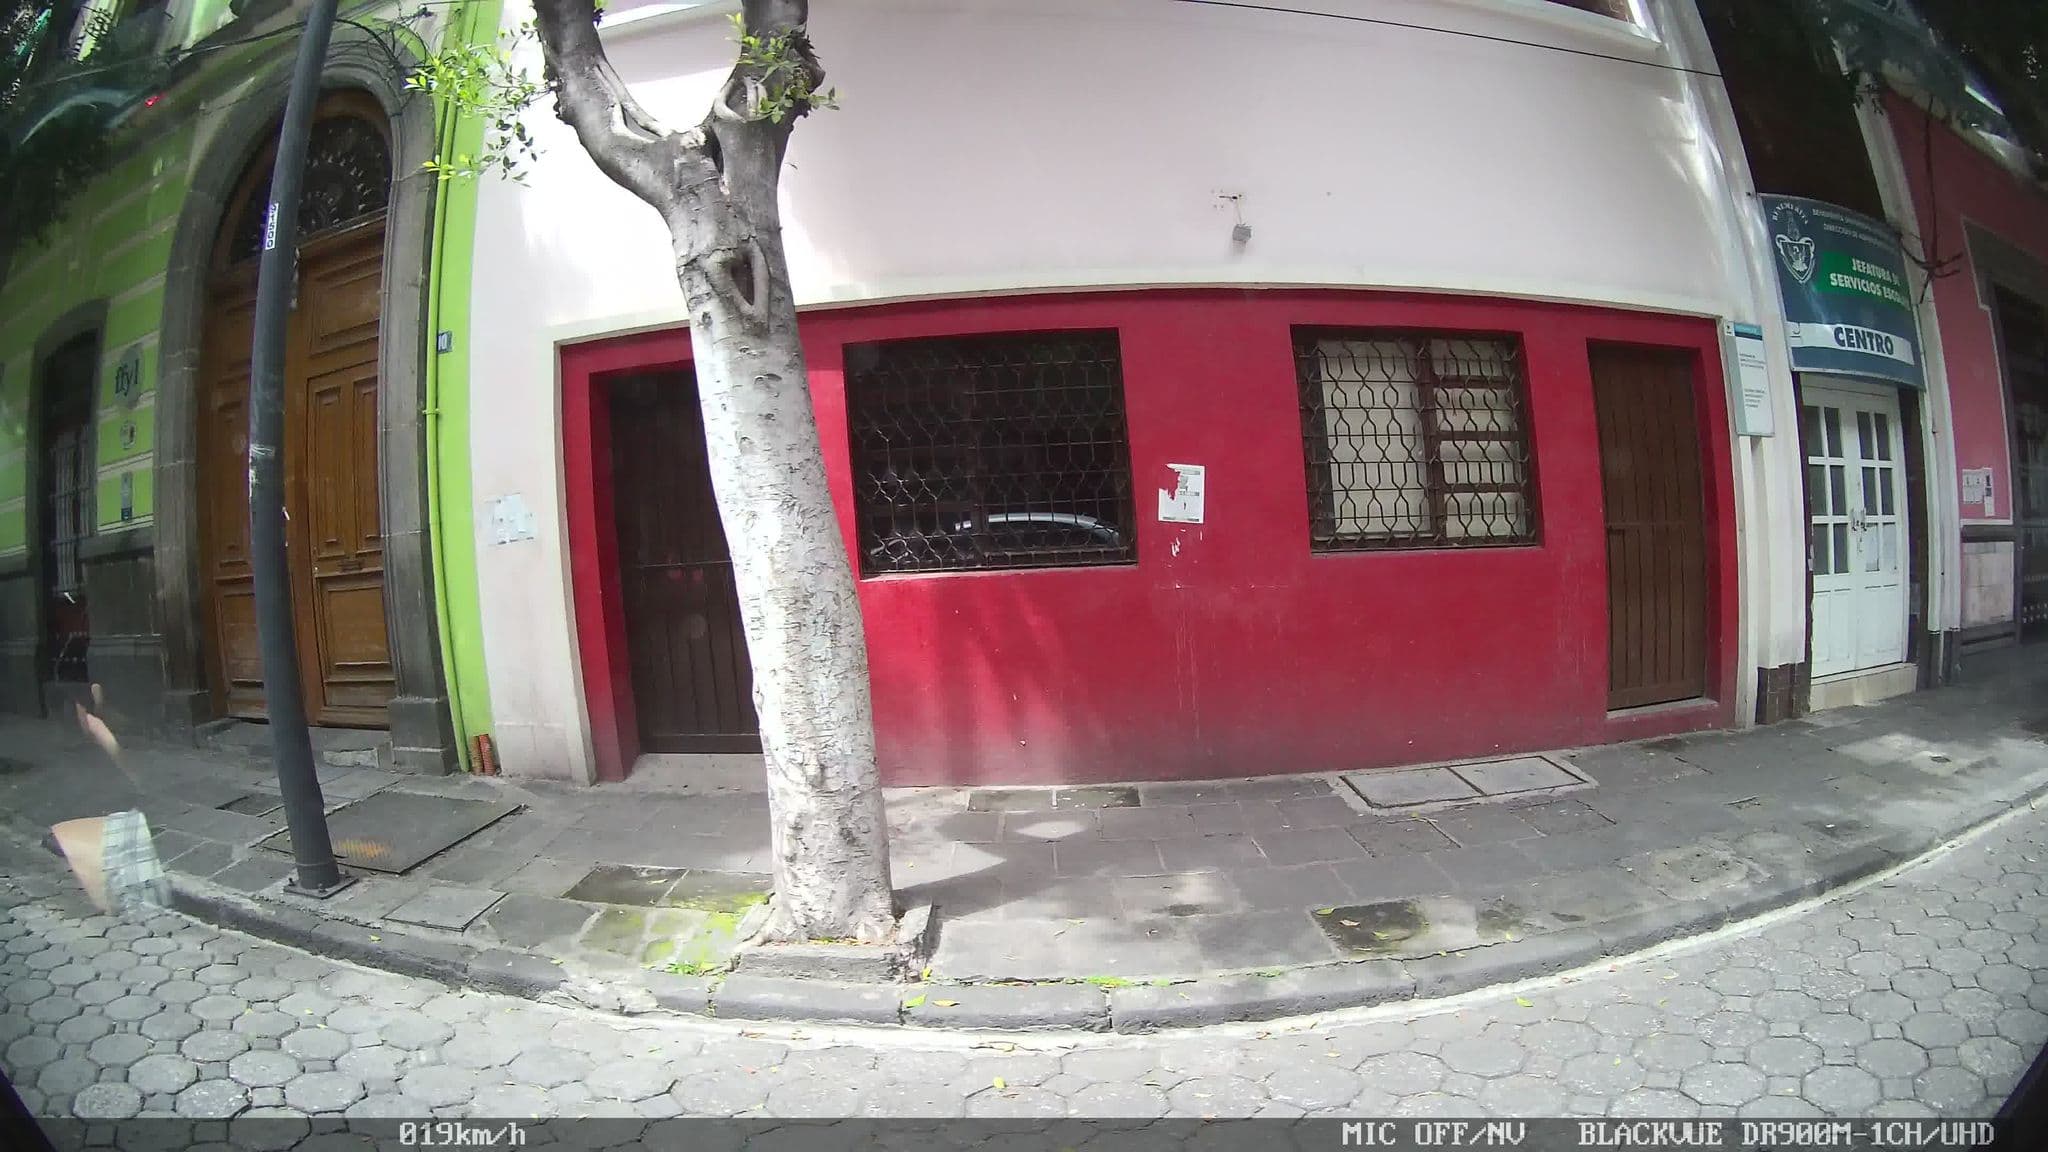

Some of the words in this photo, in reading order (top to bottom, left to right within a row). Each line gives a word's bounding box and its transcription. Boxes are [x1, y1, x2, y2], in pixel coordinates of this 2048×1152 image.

[1852, 258, 1891, 283] JEFATURA
[1830, 272, 1882, 296] SERVICIOS
[1833, 326, 1894, 355] CENTRO
